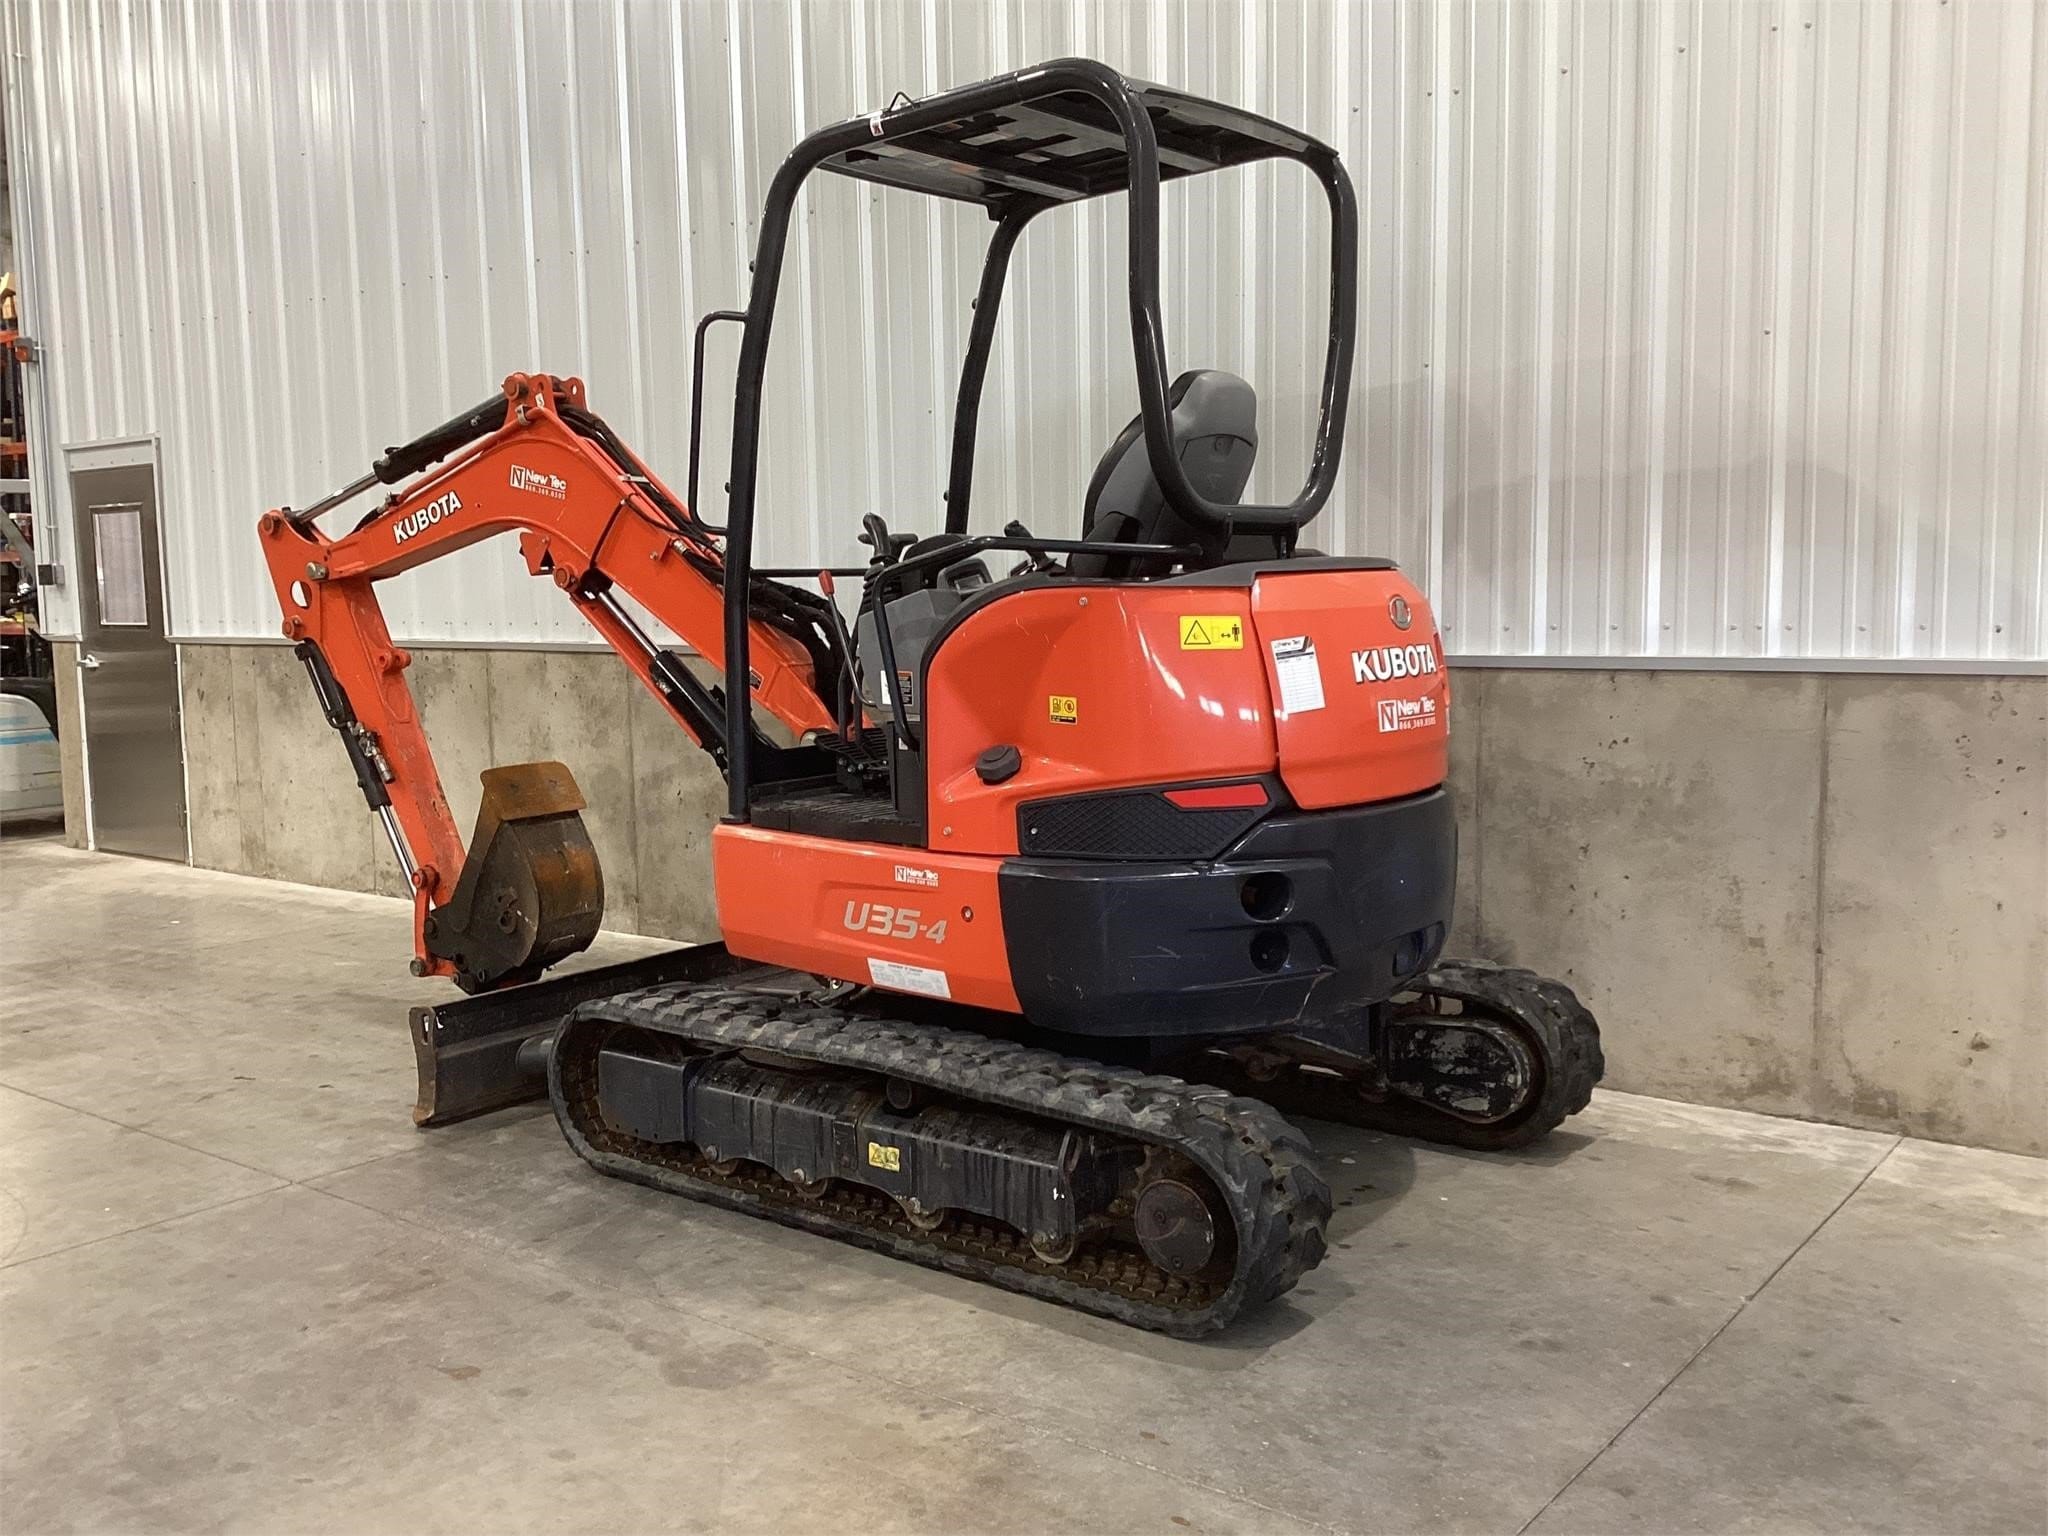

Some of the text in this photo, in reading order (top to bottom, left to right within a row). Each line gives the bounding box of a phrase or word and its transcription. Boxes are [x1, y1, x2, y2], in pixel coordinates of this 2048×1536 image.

[526, 469, 548, 485] New
[549, 474, 567, 490] Tec
[393, 490, 463, 544] KUBOTA
[1351, 644, 1437, 684] KUBOTA
[1398, 699, 1420, 716] New
[1421, 696, 1436, 713] Tec
[906, 867, 924, 878] New
[844, 900, 947, 944] U35-4
